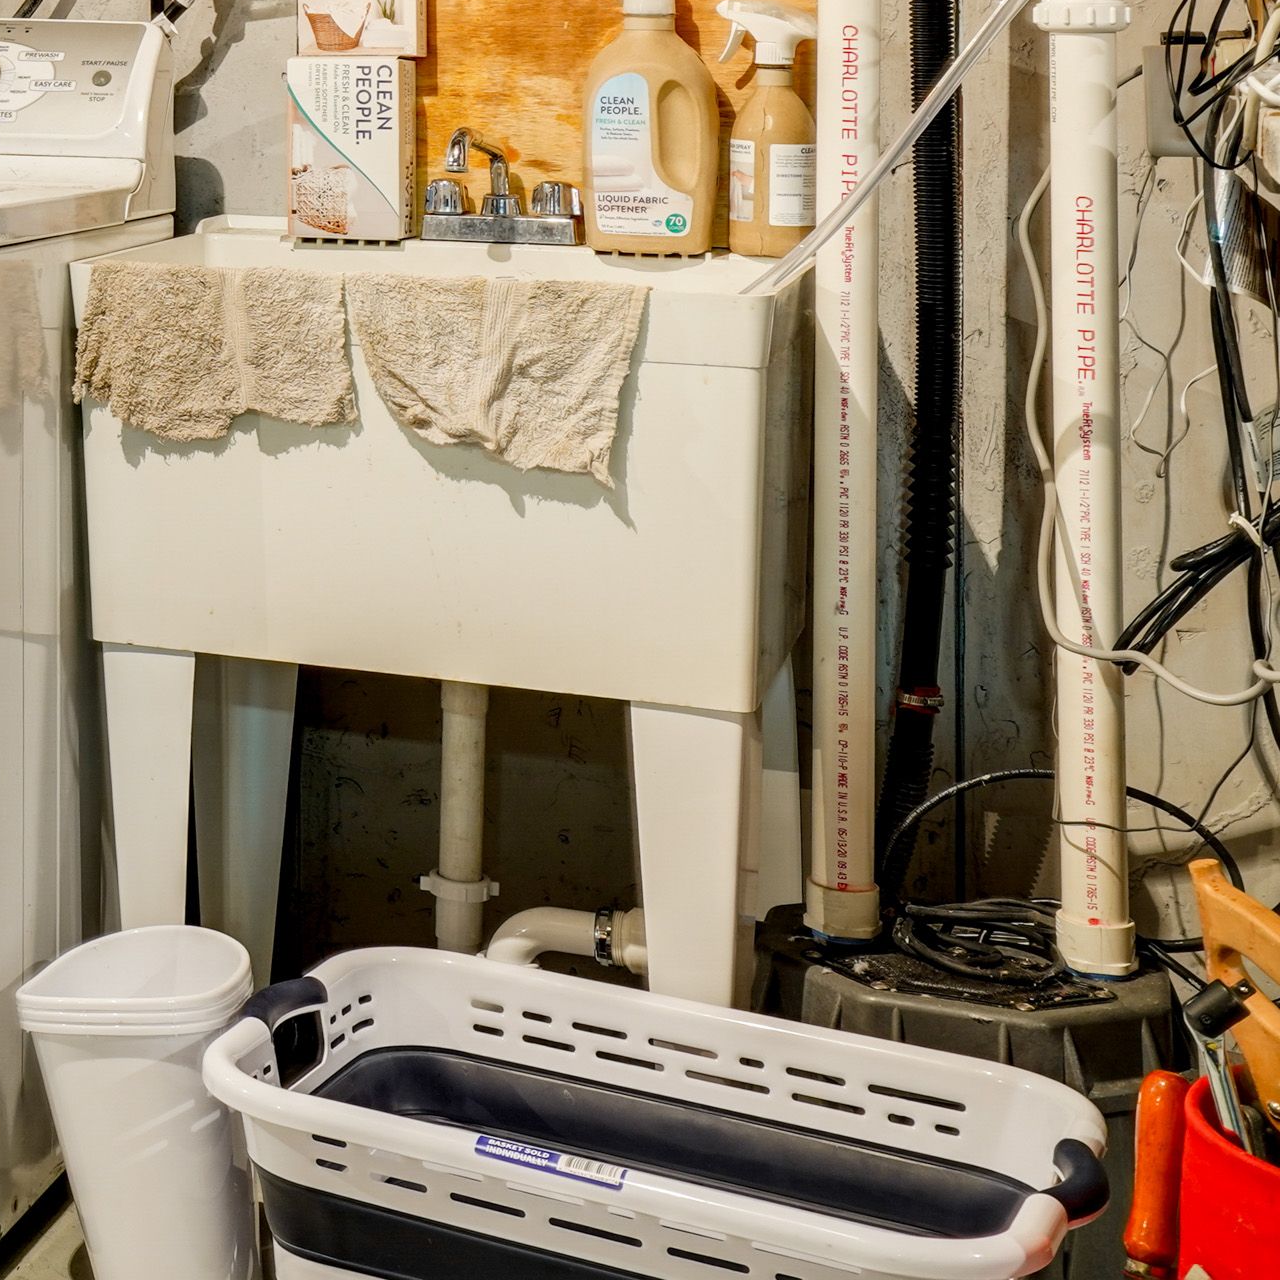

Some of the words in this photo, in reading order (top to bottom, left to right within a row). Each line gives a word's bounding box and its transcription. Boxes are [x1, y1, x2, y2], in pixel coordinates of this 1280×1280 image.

[342, 64, 350, 93] FRESH
[841, 25, 858, 140] CHARLOTTE
[376, 64, 392, 130] CLEAN
[600, 96, 634, 105] CLEAN
[356, 65, 372, 145] PEOPLE.
[600, 106, 642, 116] PEOPLE.
[342, 104, 350, 134] CLEAN
[598, 194, 630, 203] LIQUID
[632, 196, 669, 204] FABRIC
[598, 204, 648, 214] SOFTENER
[670, 216, 683, 226] 70
[1076, 196, 1095, 315] CHARLOTTE
[840, 346, 850, 361] TYPE
[840, 371, 850, 384] SCH
[840, 386, 850, 394] 40
[839, 424, 849, 440] ASTM
[839, 450, 849, 466] 2665
[839, 486, 849, 499] PVC
[839, 502, 849, 518] 1120
[839, 520, 849, 528] PR
[839, 531, 849, 542] 330
[1080, 526, 1090, 542] TYPE
[839, 546, 849, 556] PSI
[1080, 552, 1090, 565] SCH
[1080, 568, 1090, 576] 40
[1082, 606, 1092, 624] ASTM
[839, 646, 849, 661] CODE
[839, 664, 849, 679] ASTM
[1082, 672, 1093, 684] PVC
[1082, 688, 1093, 704] 1120
[1082, 706, 1093, 715] PR
[1082, 718, 1093, 730] 330
[1082, 732, 1093, 744] PSI
[838, 772, 848, 788] MADE
[838, 791, 848, 799] IN
[1086, 836, 1096, 852] CODE
[1086, 856, 1096, 872] ASTM
[486, 1145, 549, 1167] INDIVIDUALLY
[488, 1139, 523, 1152] BASKET
[524, 1148, 550, 1158] SOLD
